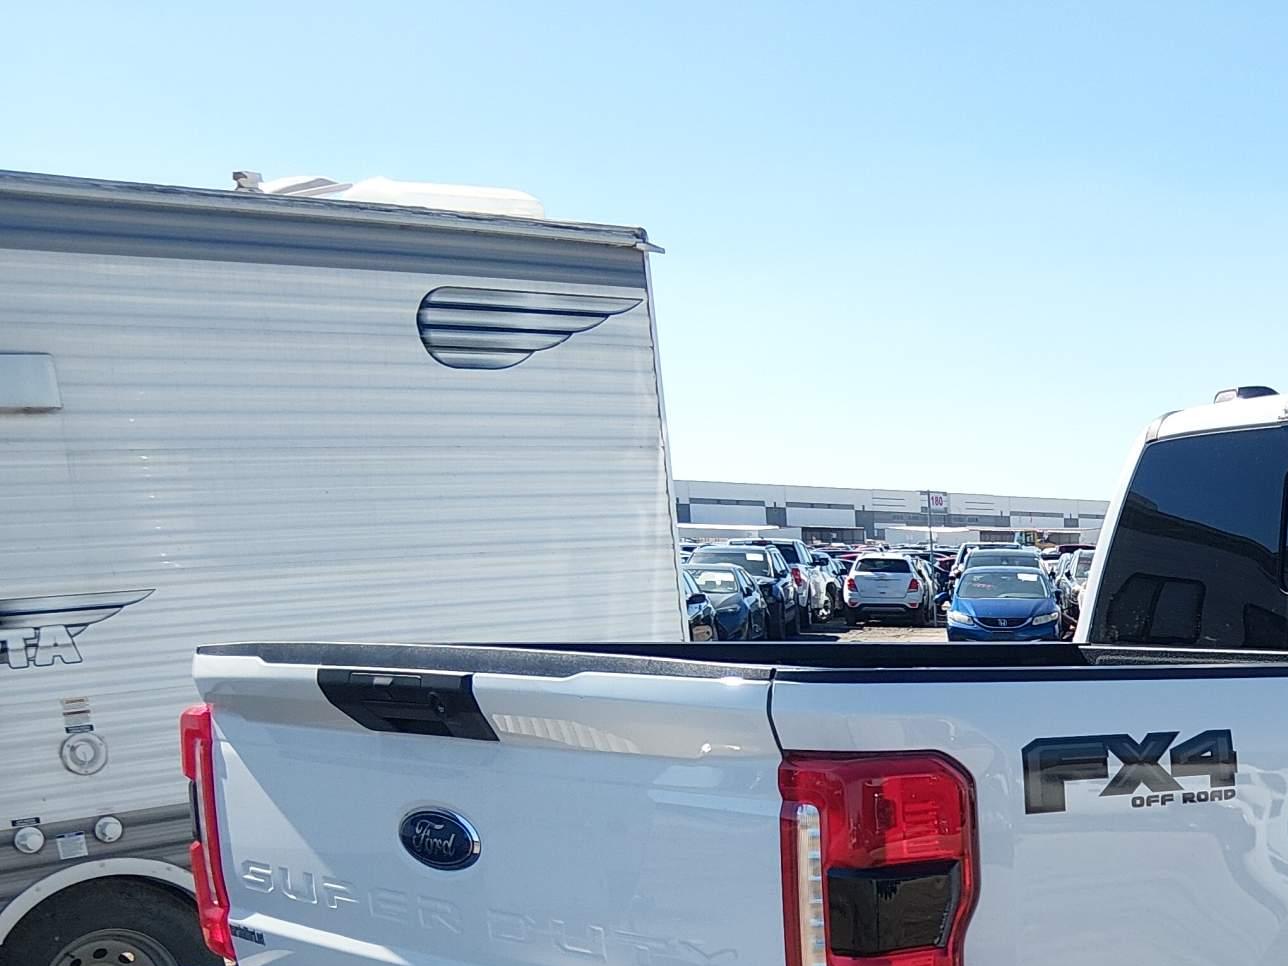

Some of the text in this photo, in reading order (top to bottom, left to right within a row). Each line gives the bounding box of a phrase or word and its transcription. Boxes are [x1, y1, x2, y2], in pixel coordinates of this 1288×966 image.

[930, 495, 944, 506] 180
[1021, 728, 1238, 815] FX4
[1131, 788, 1236, 808] OFF ROAD
[413, 818, 457, 858] Ford
[240, 859, 462, 934] SUPER
